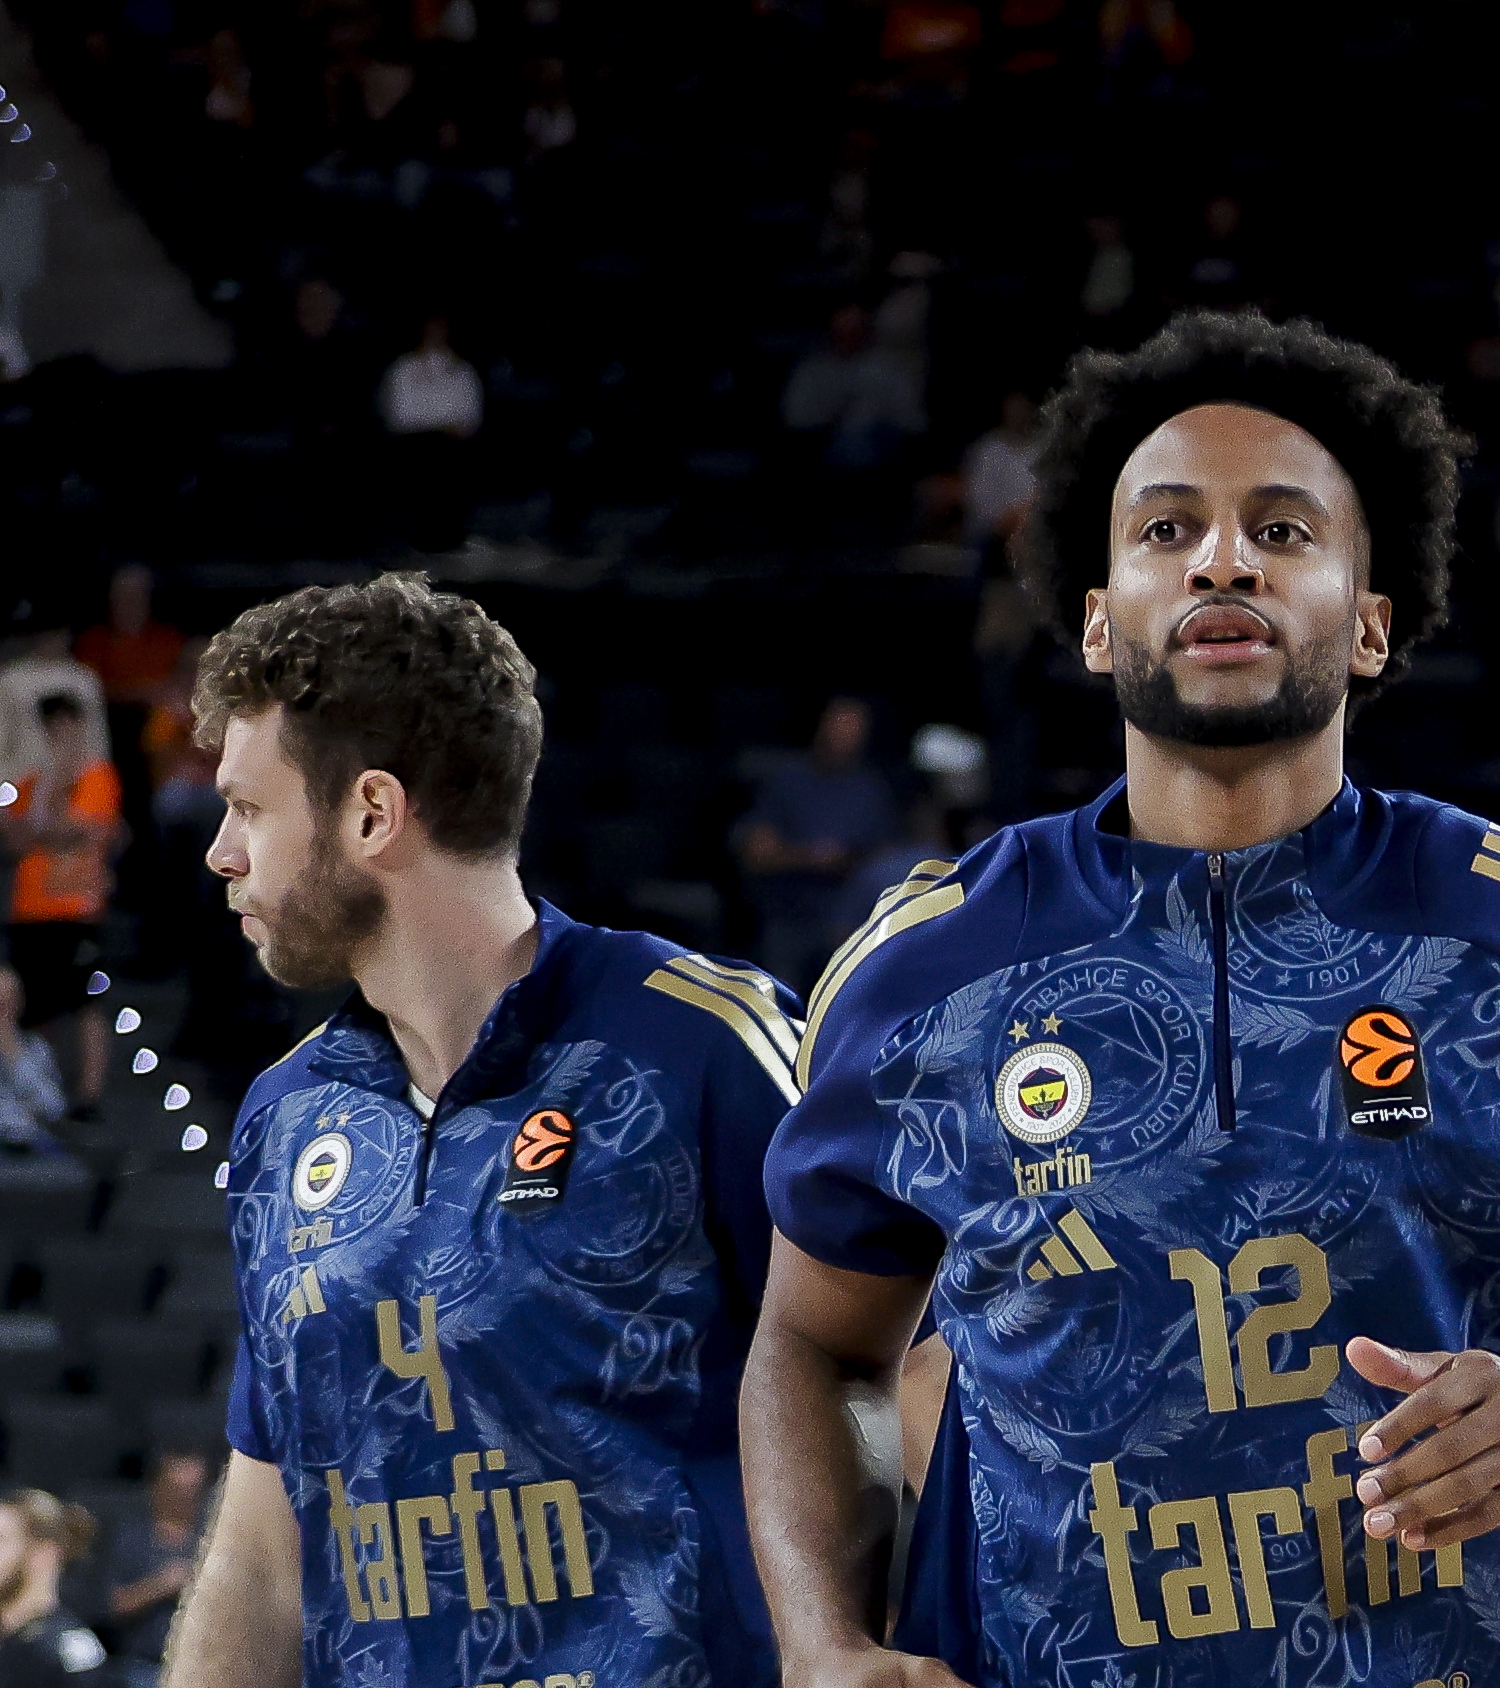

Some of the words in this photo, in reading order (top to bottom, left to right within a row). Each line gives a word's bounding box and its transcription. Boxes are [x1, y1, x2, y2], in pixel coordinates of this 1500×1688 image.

[1013, 1148, 1093, 1197] tarfin
[1351, 1107, 1427, 1124] ETIHAD
[376, 1295, 454, 1432] 4
[1170, 1236, 1340, 1414] 12
[324, 1448, 594, 1622] tarfin
